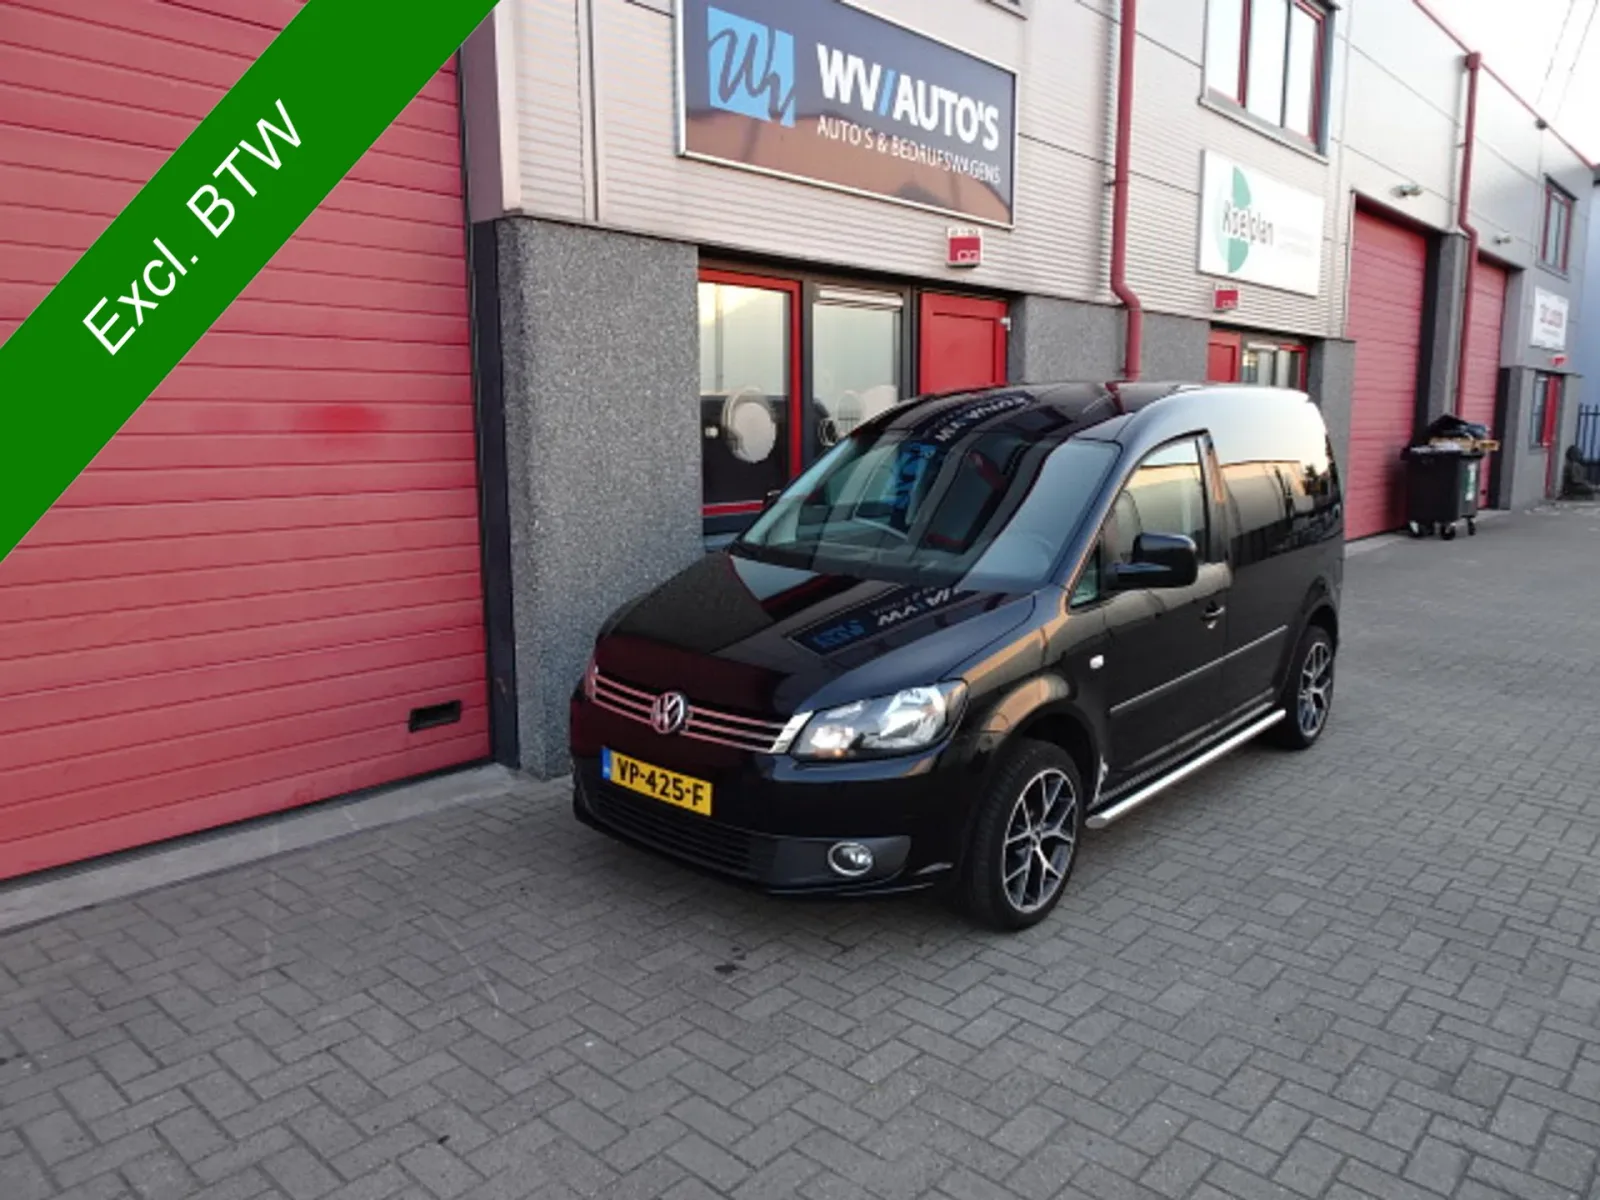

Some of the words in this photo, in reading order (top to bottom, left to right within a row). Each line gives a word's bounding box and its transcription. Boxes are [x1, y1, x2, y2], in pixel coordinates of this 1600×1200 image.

[817, 115, 874, 150] AUTO'S
[876, 132, 889, 154] &
[616, 757, 705, 806] VP-425-F
